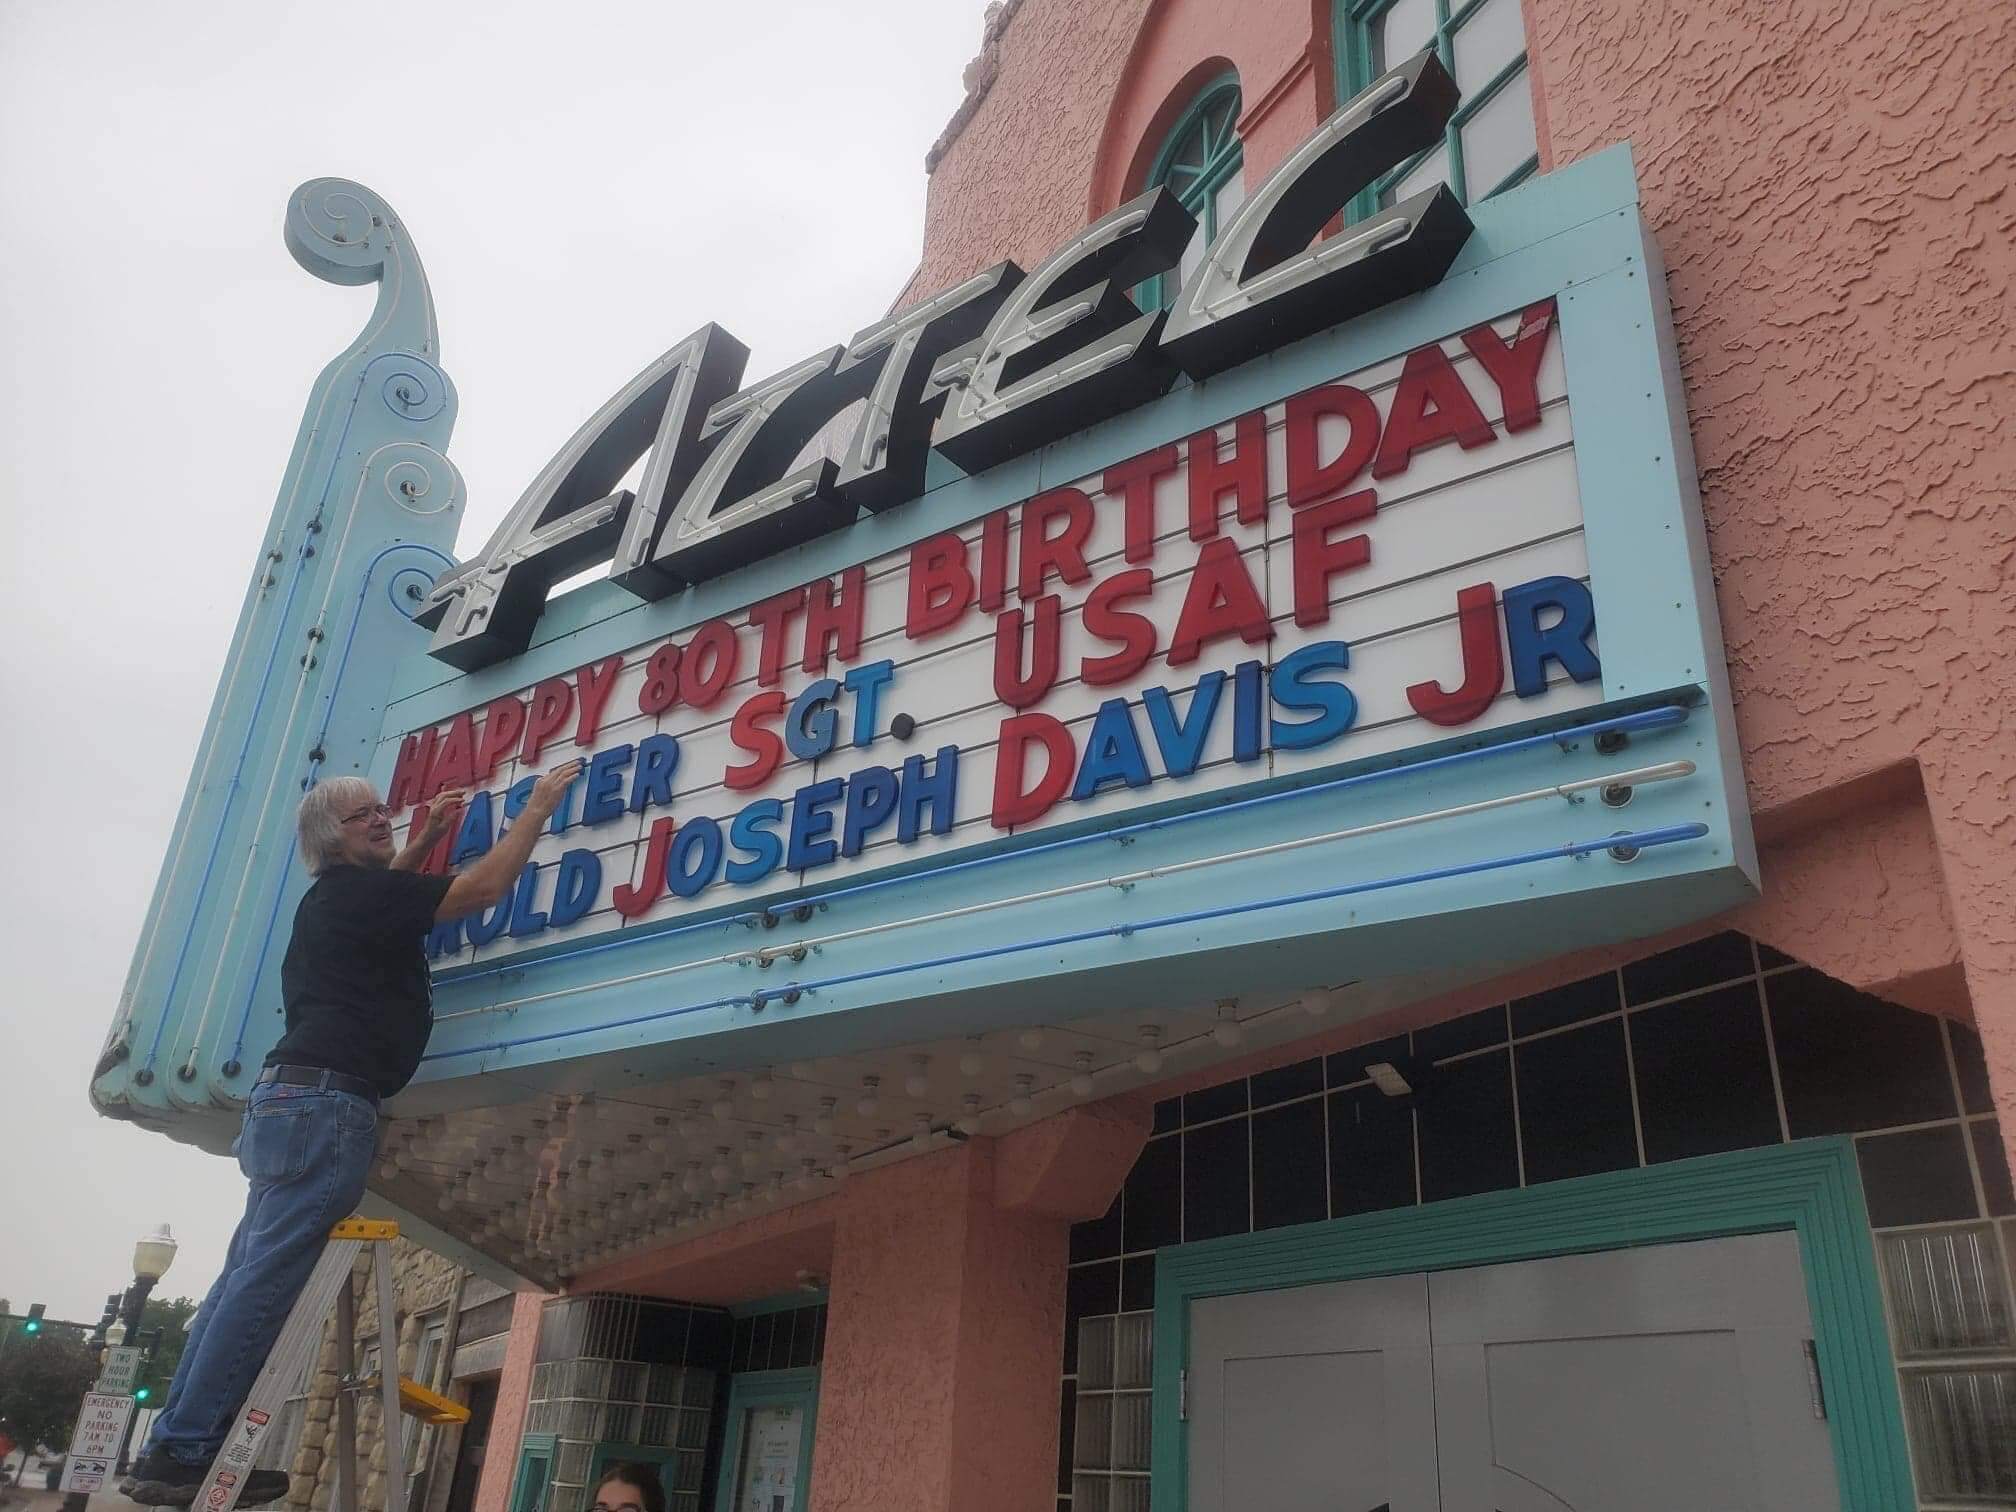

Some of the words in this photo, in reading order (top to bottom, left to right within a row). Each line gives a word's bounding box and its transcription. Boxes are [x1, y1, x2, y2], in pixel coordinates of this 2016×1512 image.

[419, 50, 1474, 671] AZTEC
[387, 656, 625, 812] HAPPY
[638, 566, 866, 716] 80TH
[905, 300, 1558, 640] BIRTHDAY
[724, 658, 916, 791] SGT.
[993, 488, 1378, 710] USAF
[612, 744, 959, 918] JOSEPH
[990, 640, 1359, 829] DAVIS
[1406, 576, 1602, 727] JR
[116, 1353, 131, 1363] TWO
[108, 1366, 131, 1376] HOUR
[87, 1397, 129, 1409] EMERGENCY
[97, 1410, 113, 1420] NO
[85, 1421, 120, 1432] PARKING
[84, 1432, 100, 1442] 7AM
